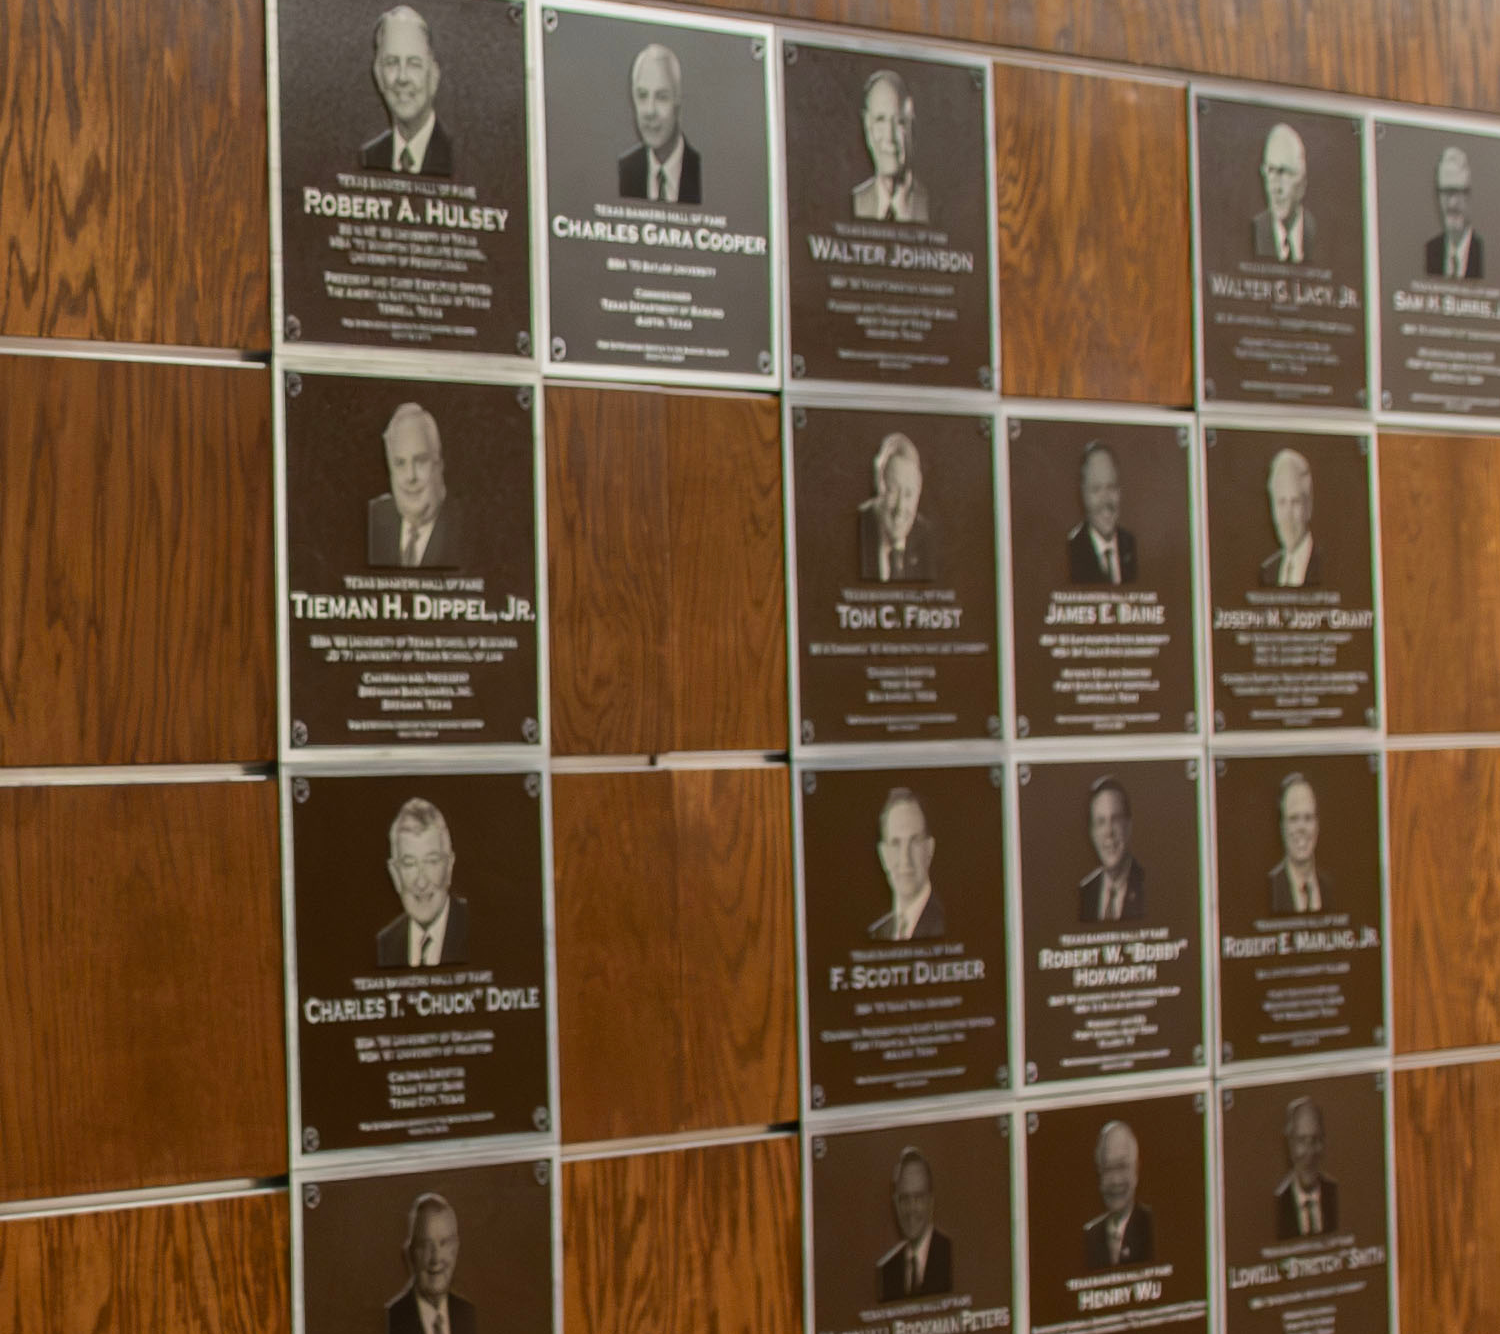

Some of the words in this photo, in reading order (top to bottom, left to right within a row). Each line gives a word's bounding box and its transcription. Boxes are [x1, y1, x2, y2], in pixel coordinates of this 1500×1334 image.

[304, 187, 392, 219] ROBERT
[397, 197, 420, 222] A.
[426, 199, 508, 230] HULSEY
[553, 215, 639, 243] CHARLES
[642, 224, 693, 248] GARA
[695, 228, 768, 254] COOPER
